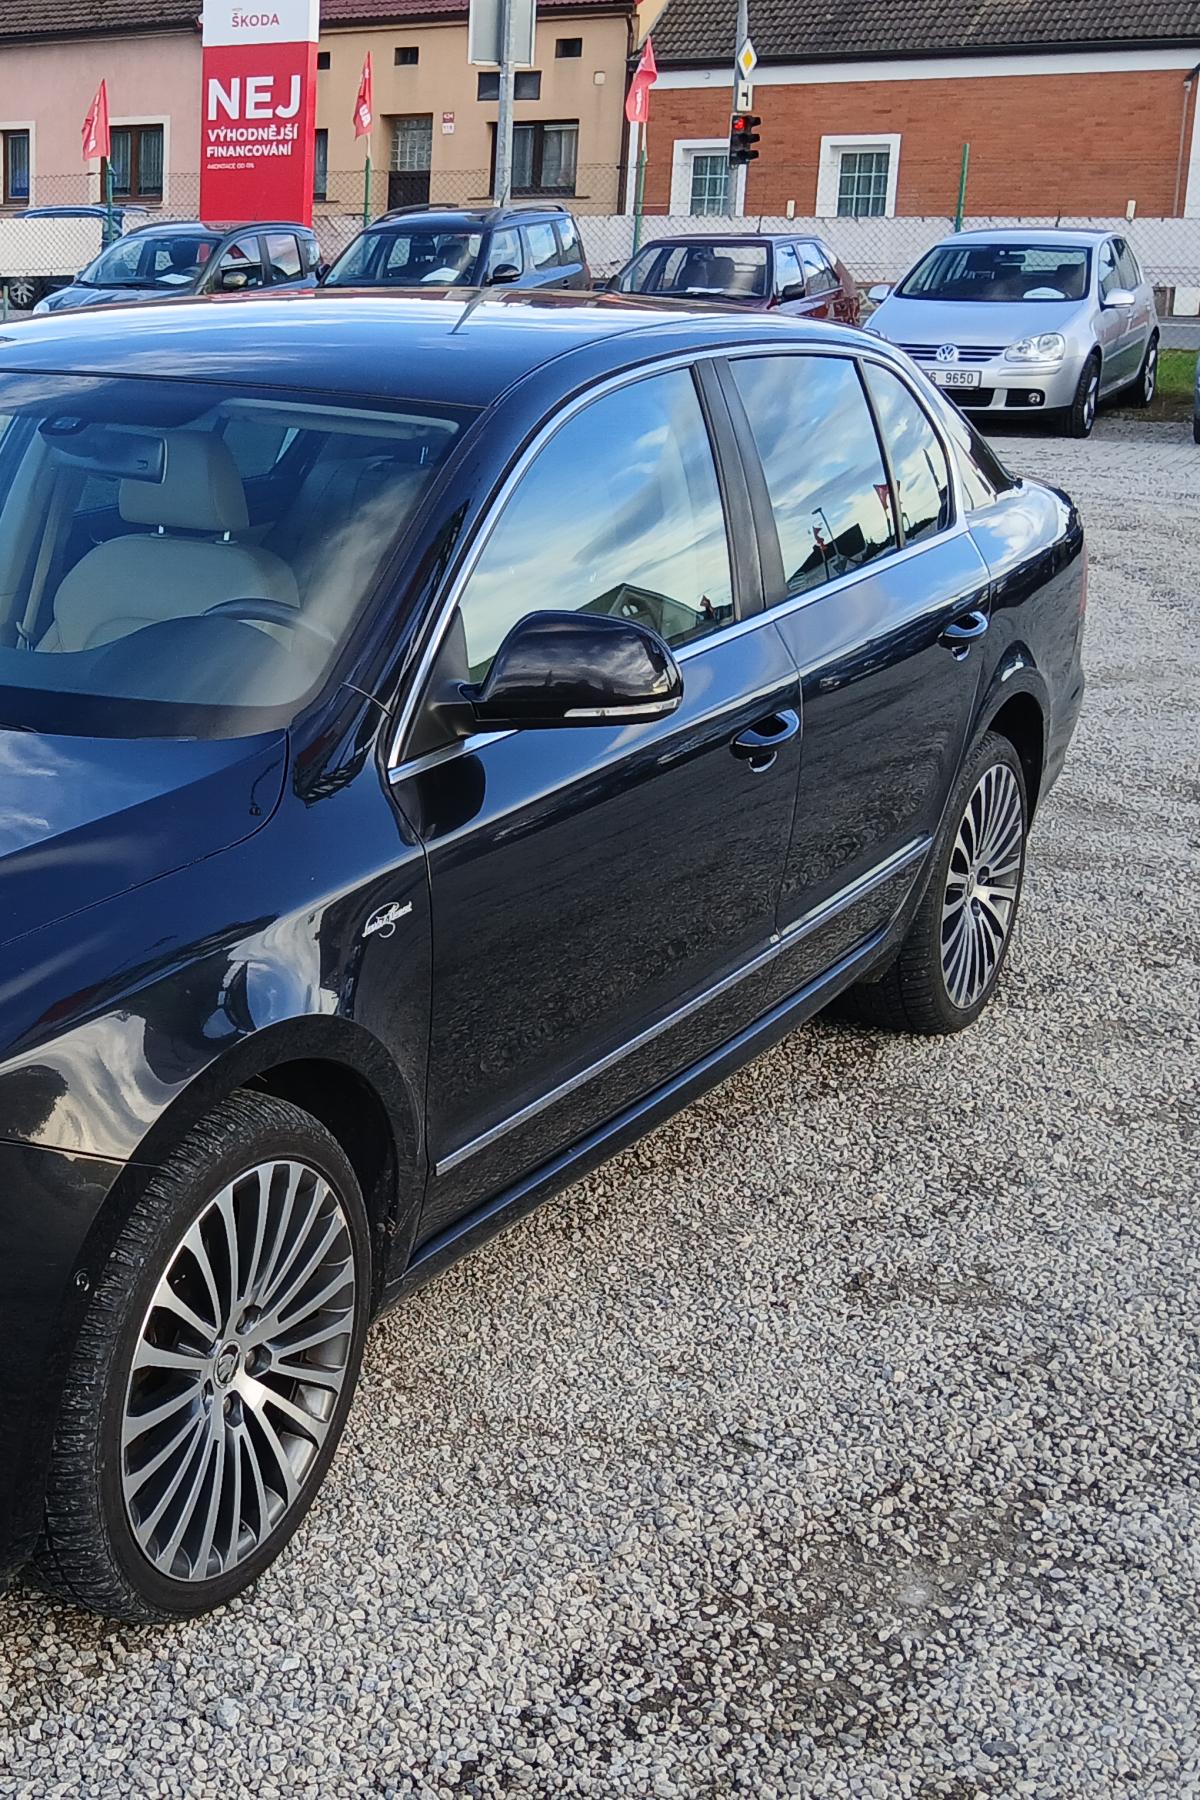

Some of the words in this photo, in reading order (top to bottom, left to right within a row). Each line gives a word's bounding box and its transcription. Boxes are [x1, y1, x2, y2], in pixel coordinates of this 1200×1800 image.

[231, 13, 280, 28] ŠKODA
[207, 75, 301, 121] NEJ
[207, 123, 299, 143] VÝHODNĚJŠÍ
[206, 141, 292, 158] FINANCOVÁNÍ
[945, 372, 974, 384] 9650
